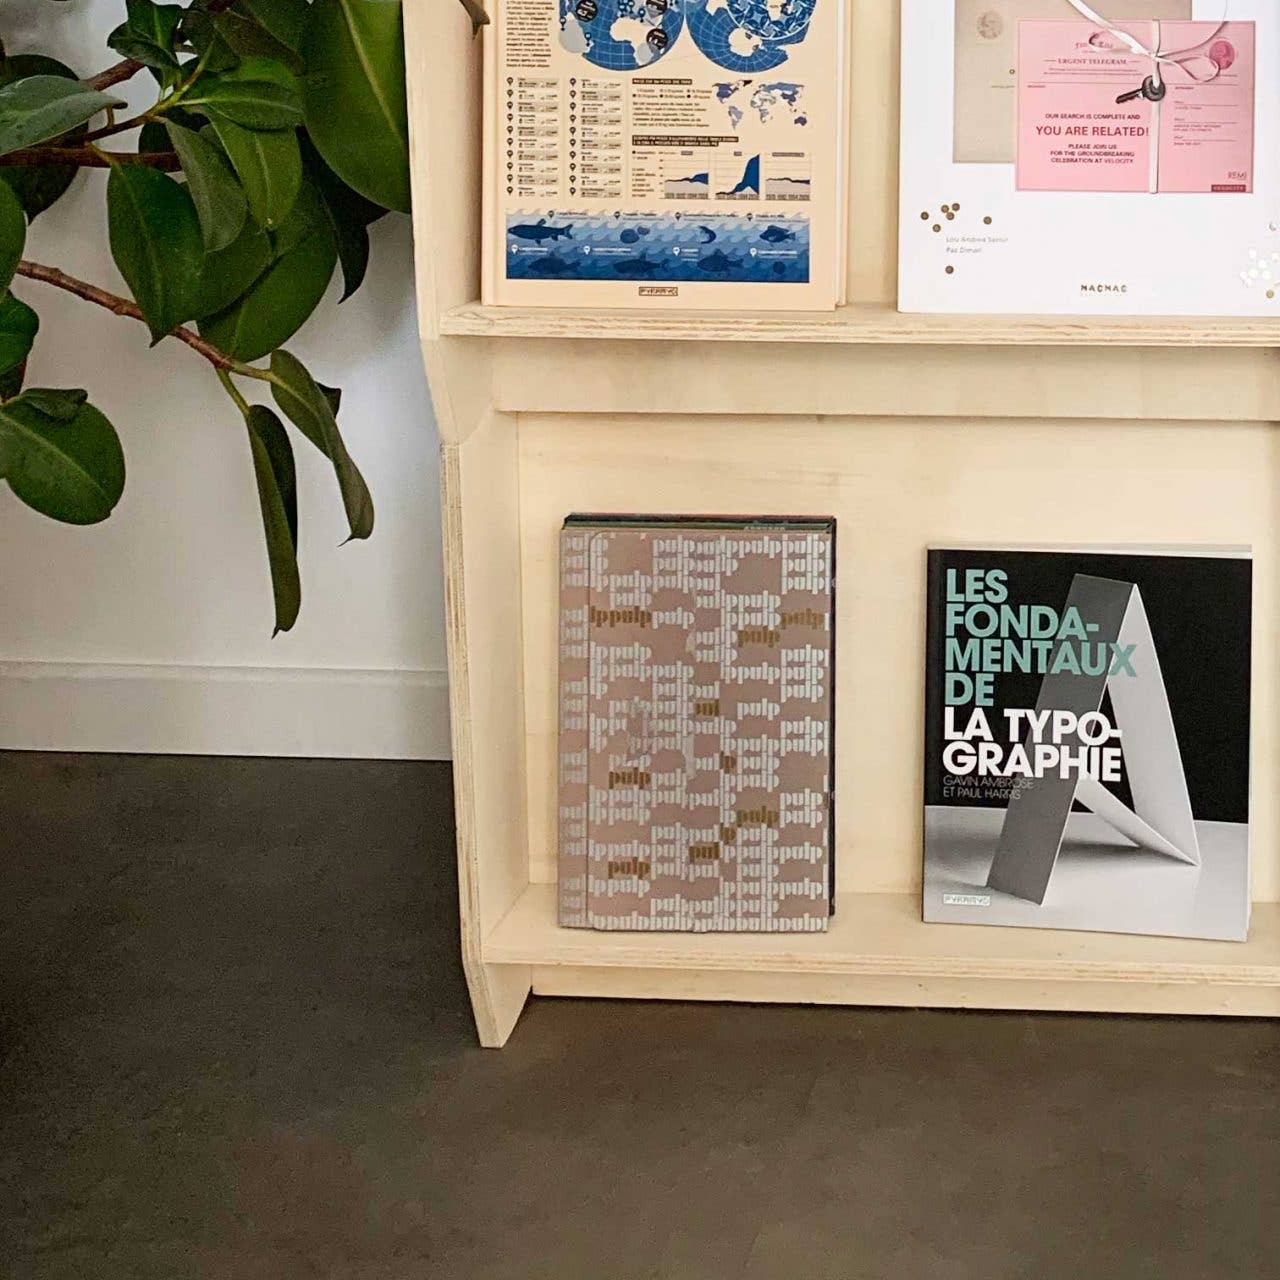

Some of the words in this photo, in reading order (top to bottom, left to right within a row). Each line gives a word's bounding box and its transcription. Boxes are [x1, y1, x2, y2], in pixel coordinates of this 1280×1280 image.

[1036, 125, 1061, 136] YOU
[1065, 126, 1089, 136] ARE
[1092, 126, 1149, 137] RELATED!
[946, 568, 1009, 603] LES
[945, 603, 1100, 641] FONDA-
[944, 638, 1138, 678] MENTAUX
[944, 672, 995, 707] DE
[944, 707, 992, 741] LA
[1003, 708, 1123, 748] TYPO-
[942, 741, 1122, 783] GRAPHIE
[943, 775, 978, 786] GAVIN
[980, 776, 1035, 789] AMBROSE
[943, 787, 955, 798] ET
[957, 787, 982, 798] PAUL
[985, 788, 1022, 799] HARRIS
